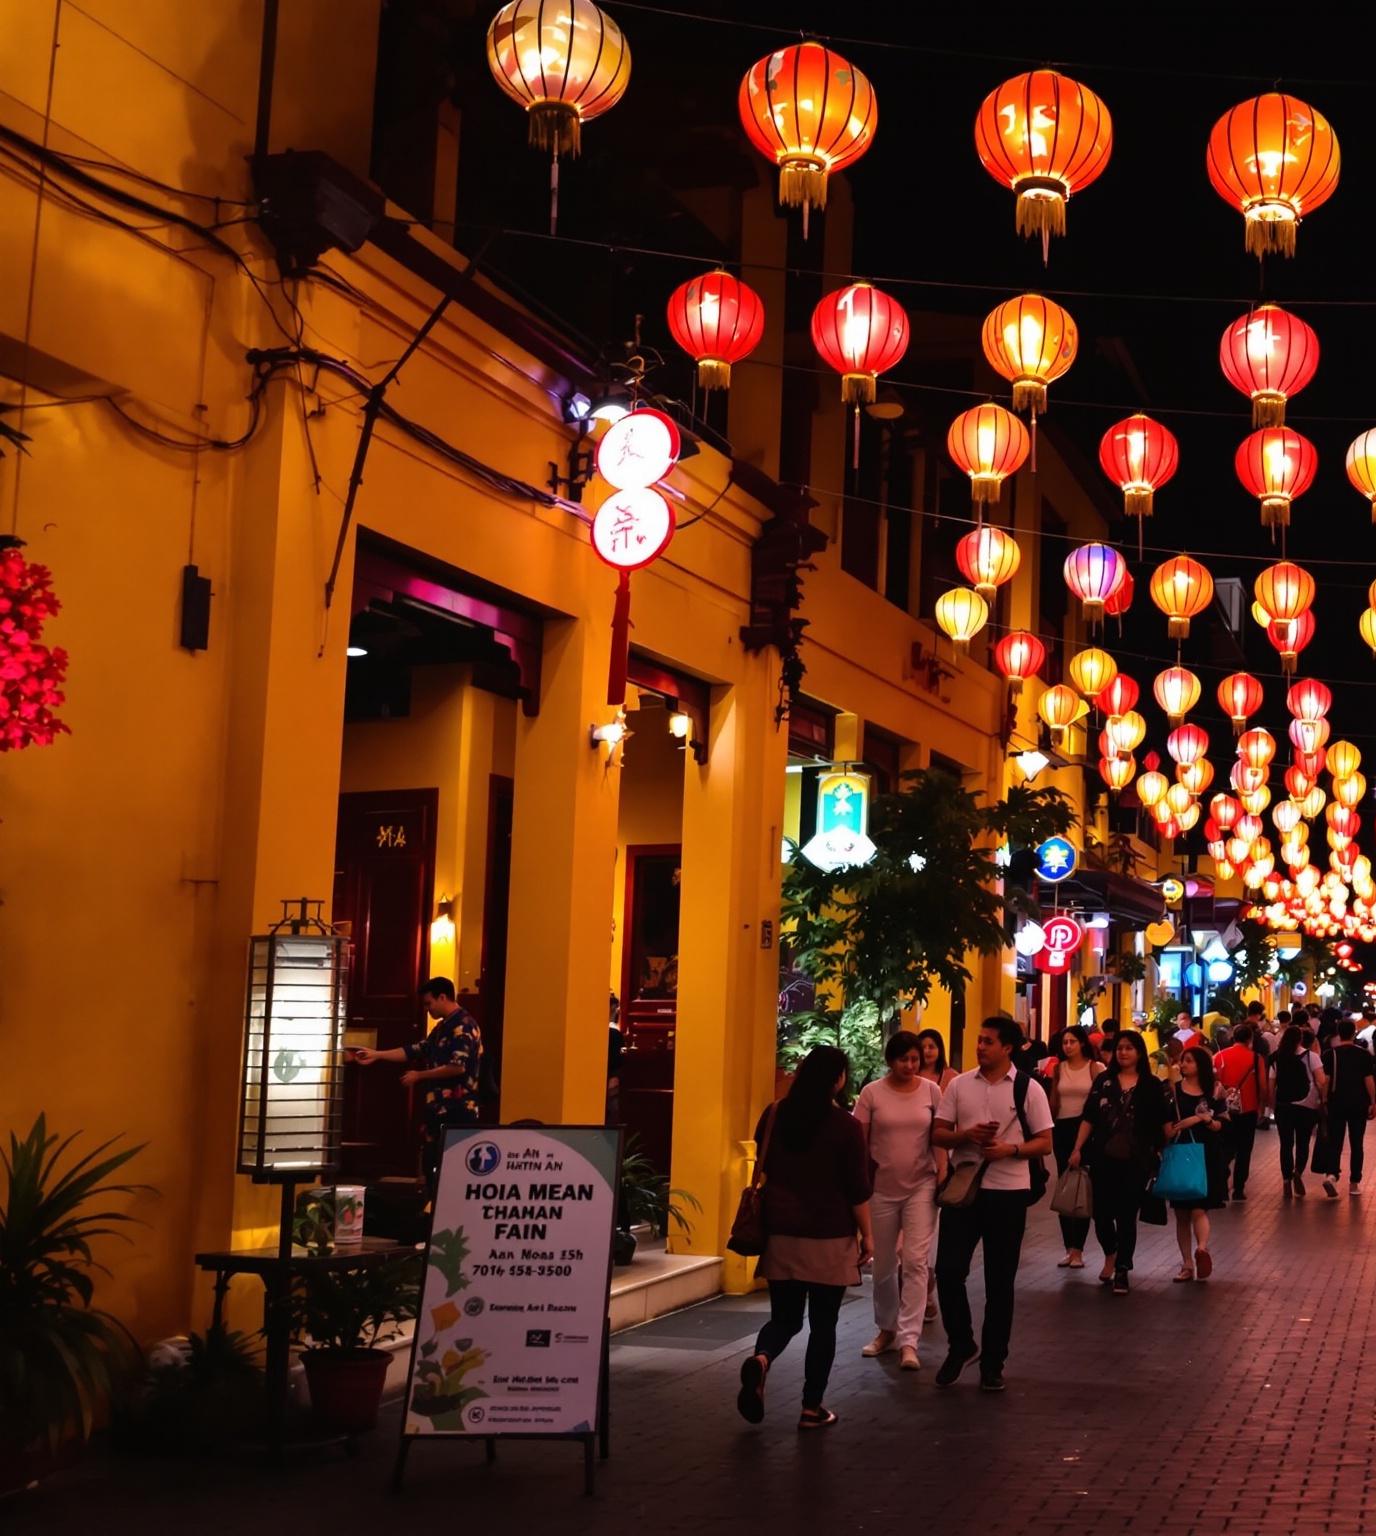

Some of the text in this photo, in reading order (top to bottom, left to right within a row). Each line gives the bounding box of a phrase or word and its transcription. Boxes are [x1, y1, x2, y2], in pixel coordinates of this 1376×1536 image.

[465, 1183, 594, 1201] HOIA MEAN
[494, 1223, 547, 1240] FAIN
